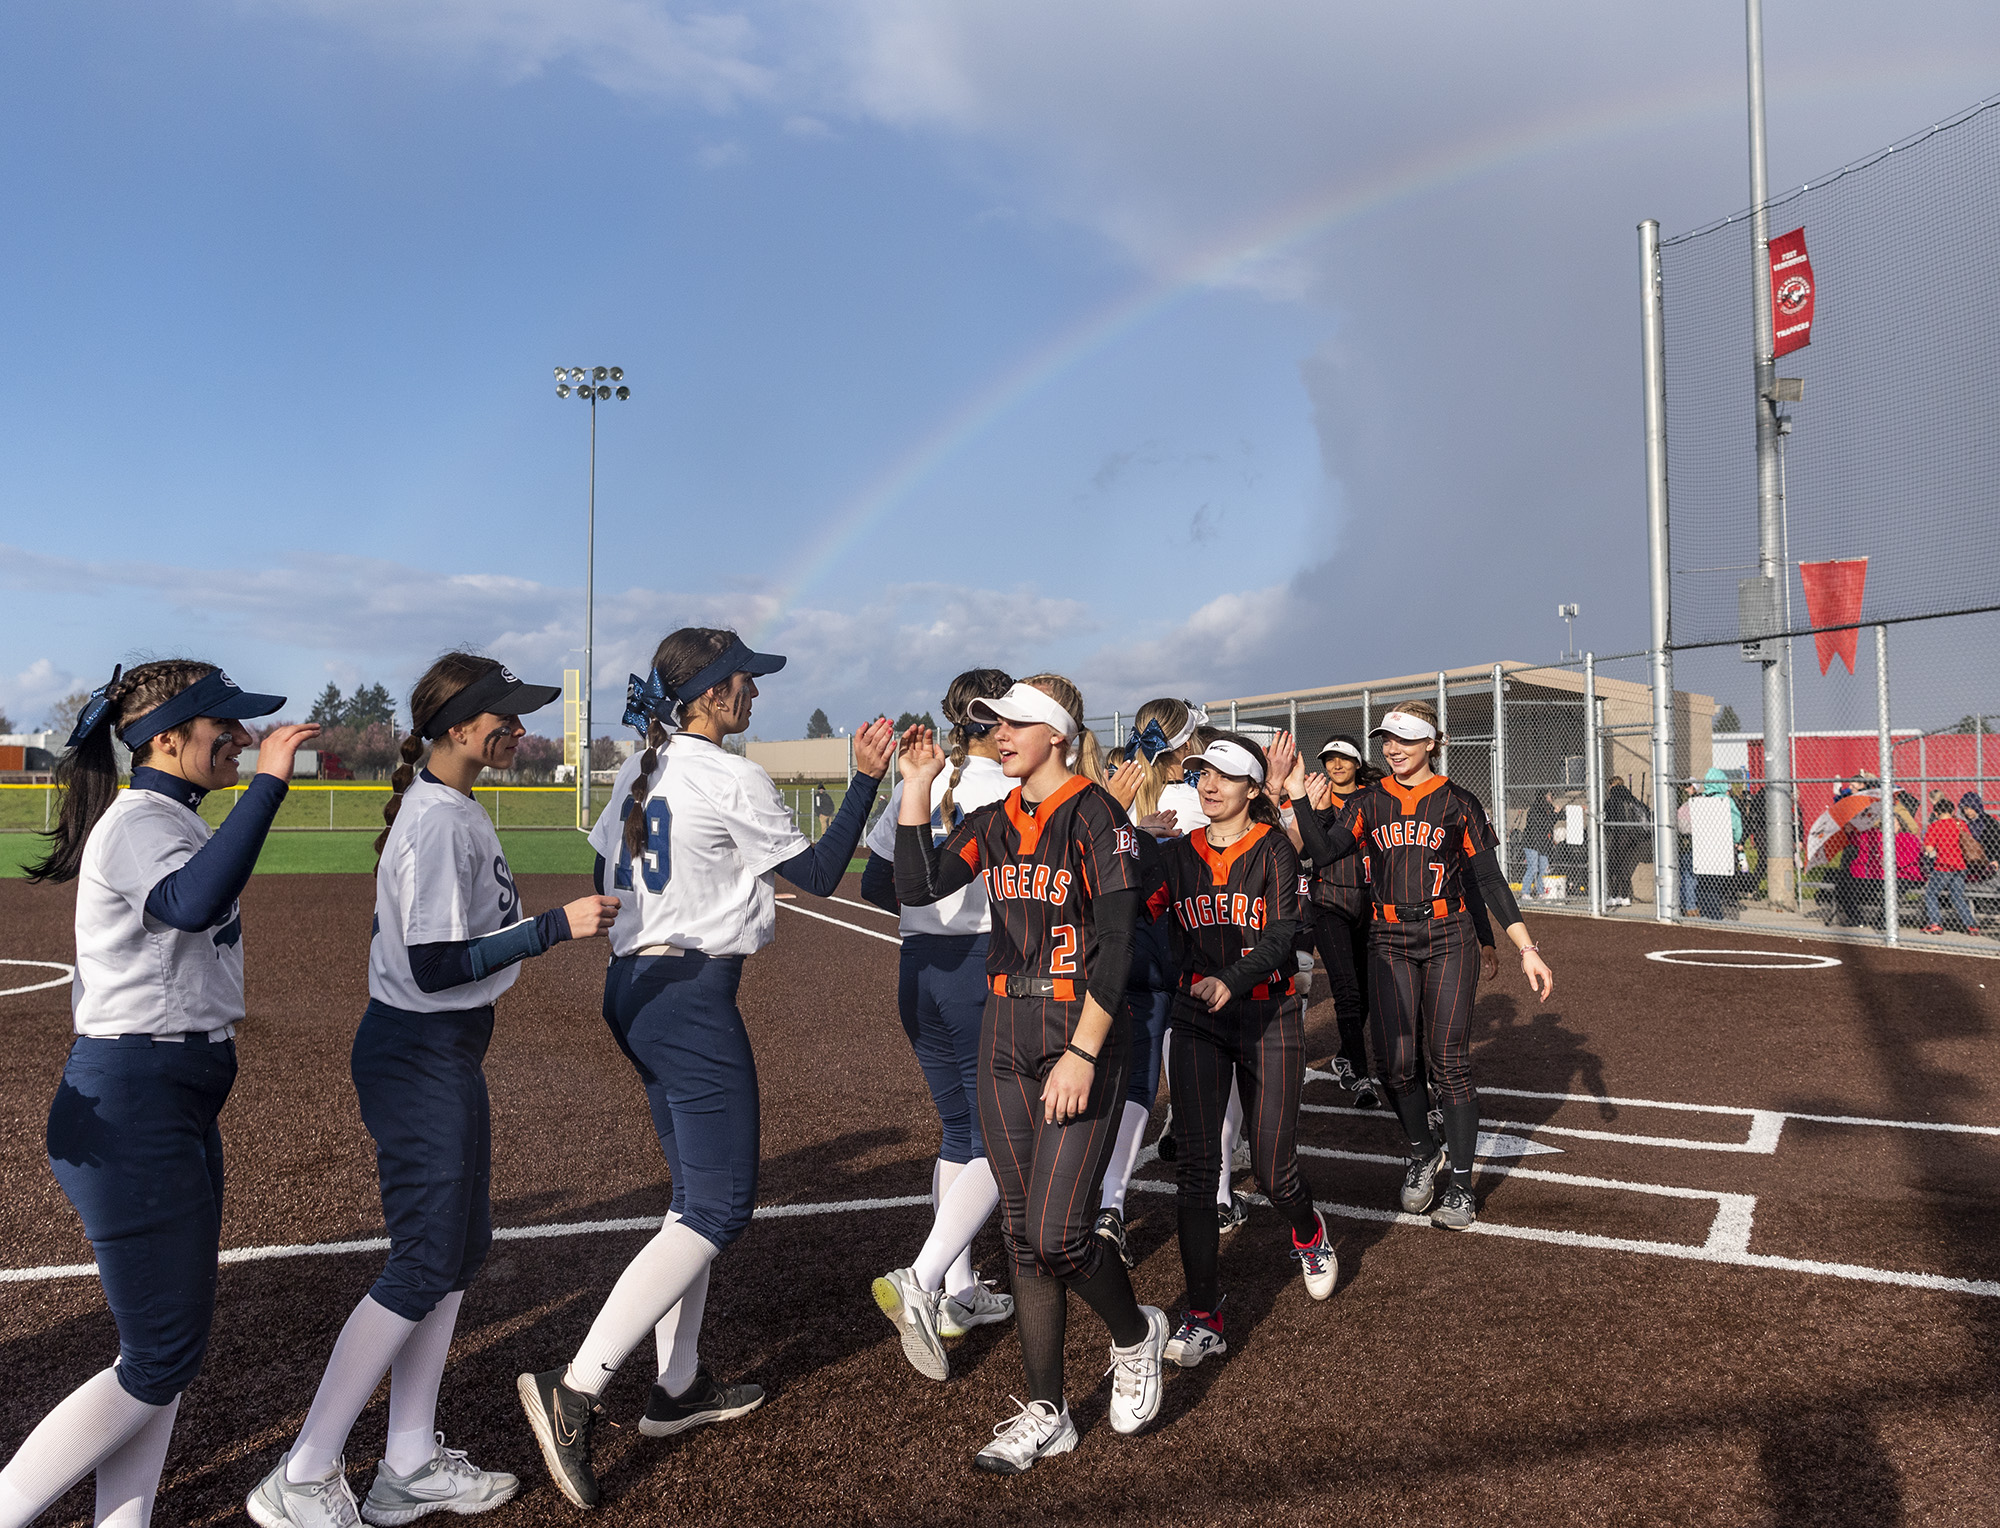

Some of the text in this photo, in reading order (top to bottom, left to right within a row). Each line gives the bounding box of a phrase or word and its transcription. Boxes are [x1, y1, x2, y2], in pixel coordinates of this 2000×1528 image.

[1776, 321, 1809, 338] TRAPPERS
[1371, 820, 1446, 852] TIGERS
[982, 863, 1072, 906] TIGERS
[1428, 862, 1445, 897] 7
[1173, 892, 1264, 932] TIGERS
[1049, 923, 1077, 974] 2
